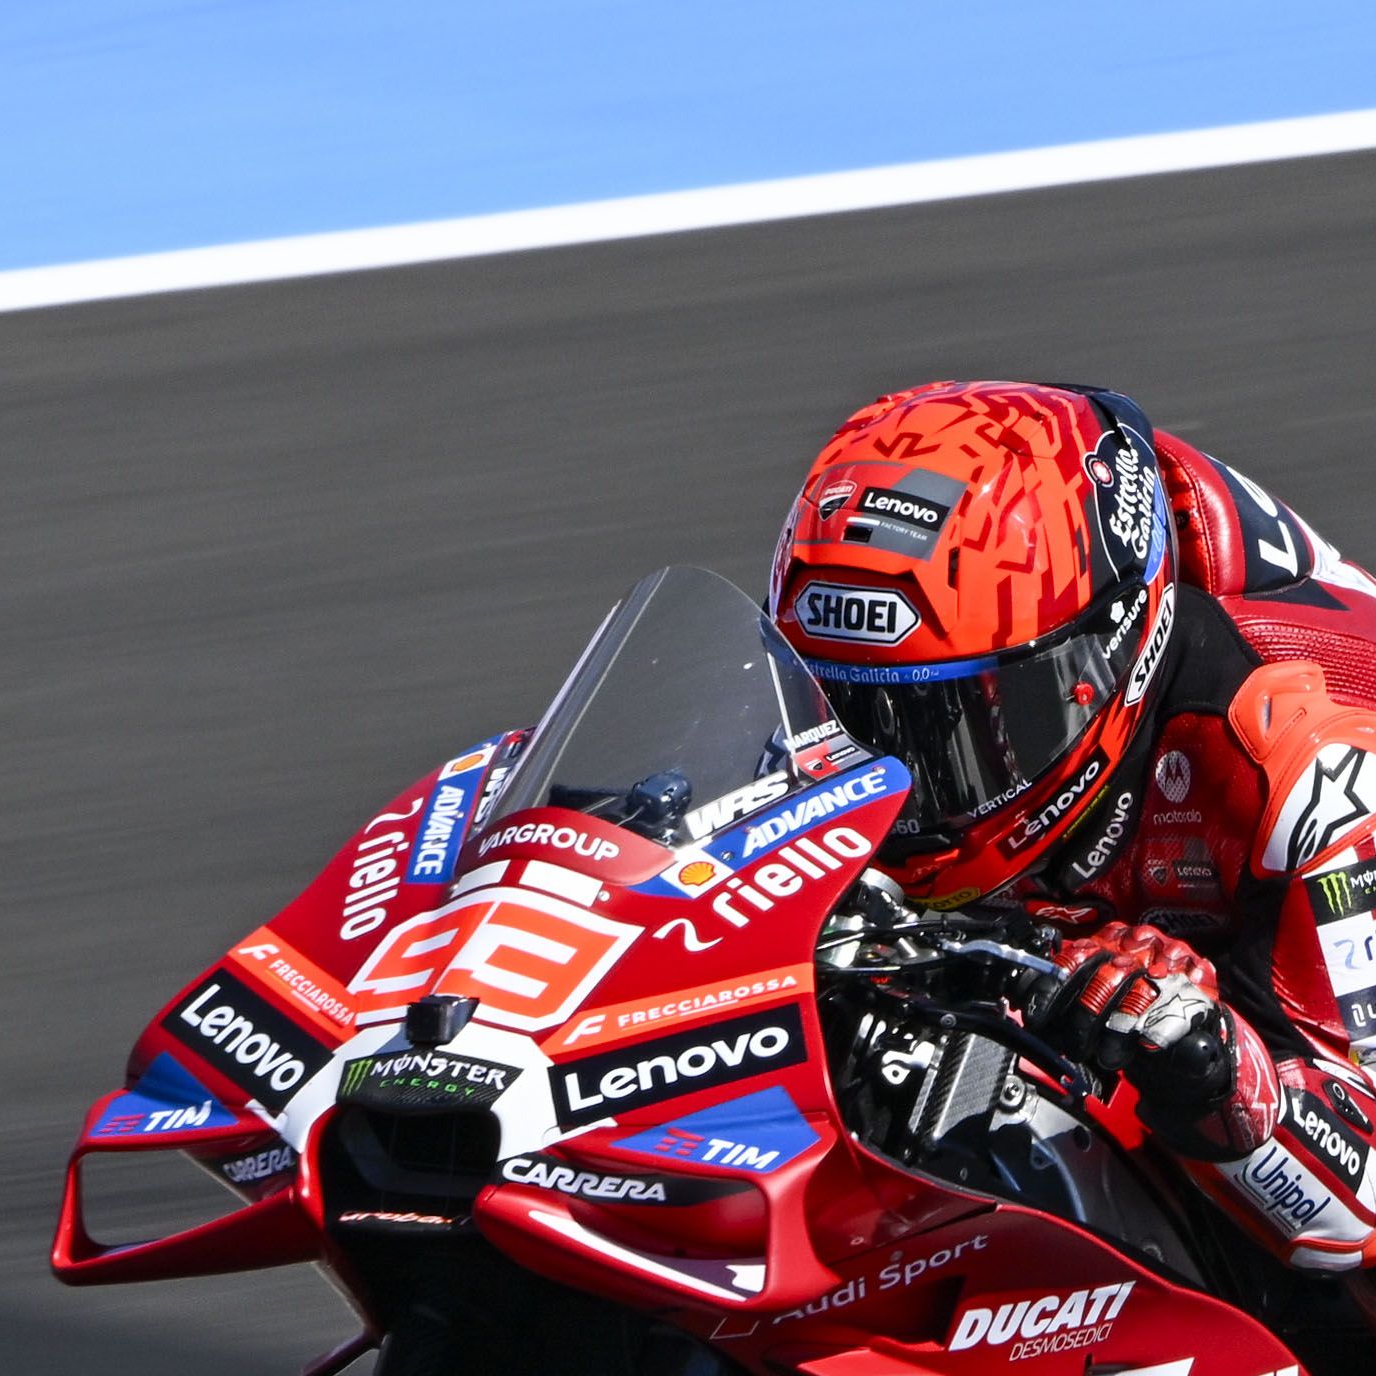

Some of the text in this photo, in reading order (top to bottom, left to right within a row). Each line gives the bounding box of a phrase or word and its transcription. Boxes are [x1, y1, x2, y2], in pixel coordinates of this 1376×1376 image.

[864, 492, 938, 523] Lenovo
[880, 522, 928, 541] FACTORY TEAM
[1109, 448, 1139, 546] Estrella
[1130, 466, 1157, 559] Galicia
[807, 593, 898, 634] SHOEI
[1102, 589, 1147, 660] verisure
[1134, 599, 1173, 692] SHOEI
[805, 662, 847, 681] strella
[849, 666, 900, 683] Galicia
[783, 719, 842, 751] MARQUEZ
[413, 785, 465, 876] ADVANCE
[685, 770, 790, 841] WRS
[742, 772, 888, 858] ADVANCE
[967, 779, 1033, 819] VERTICAL
[1007, 761, 1101, 850] Lenovo
[1153, 809, 1203, 825] motorola
[1072, 792, 1134, 879] Lenovo
[339, 831, 406, 942] riello
[712, 826, 873, 929] riello
[268, 958, 356, 1026] FRECCIAROSSA
[618, 975, 798, 1028] FRECCIAROSSA
[179, 983, 306, 1092] Lenovo
[564, 1026, 790, 1113] Lenovo
[143, 1099, 213, 1132] TIM
[1292, 1097, 1362, 1177] Lenovo
[501, 1157, 666, 1203] CARRERA
[701, 1138, 781, 1170] TIM
[1251, 1146, 1331, 1226] Unipol
[878, 1232, 989, 1291] Sport
[948, 1280, 1138, 1353] DUCATI
[1009, 1321, 1114, 1362] DESMOSEDICI
